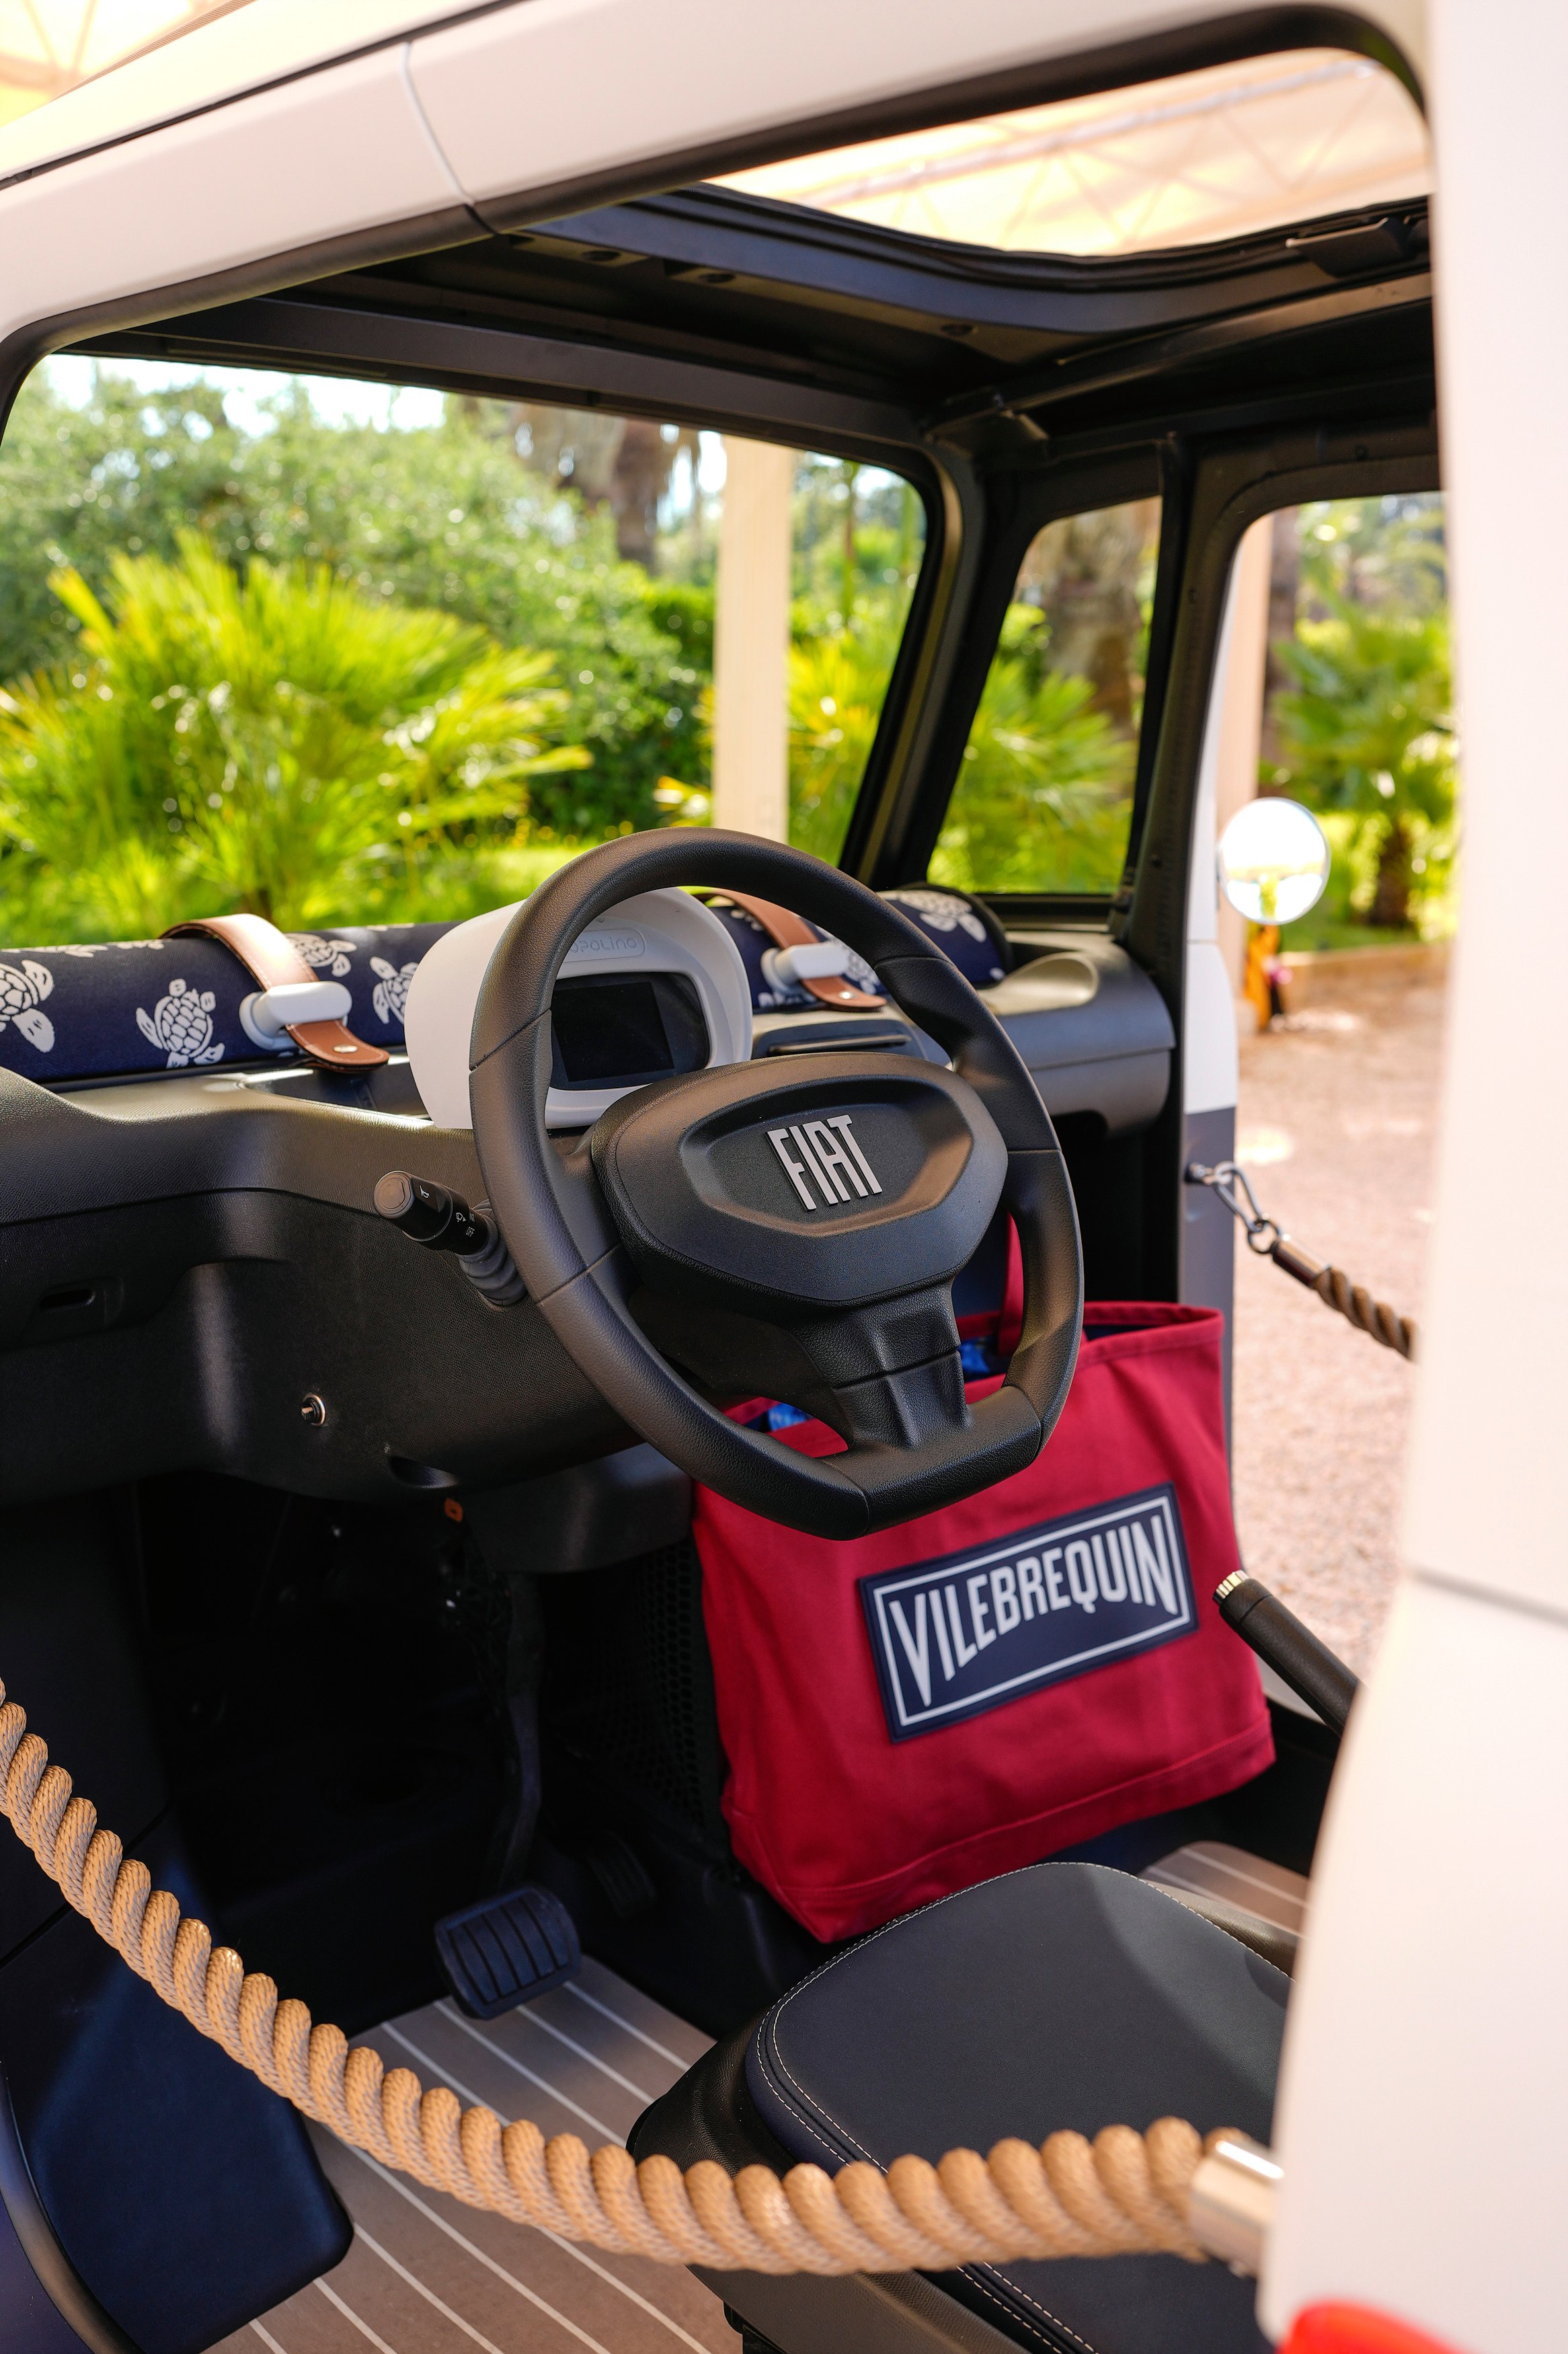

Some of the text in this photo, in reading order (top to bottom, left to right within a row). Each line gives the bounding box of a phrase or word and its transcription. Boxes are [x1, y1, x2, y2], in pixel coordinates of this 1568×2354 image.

[766, 1114, 883, 1213] FIAT
[465, 1226, 475, 1238] OFF
[889, 1514, 1179, 1708] VILEBREQUIN
